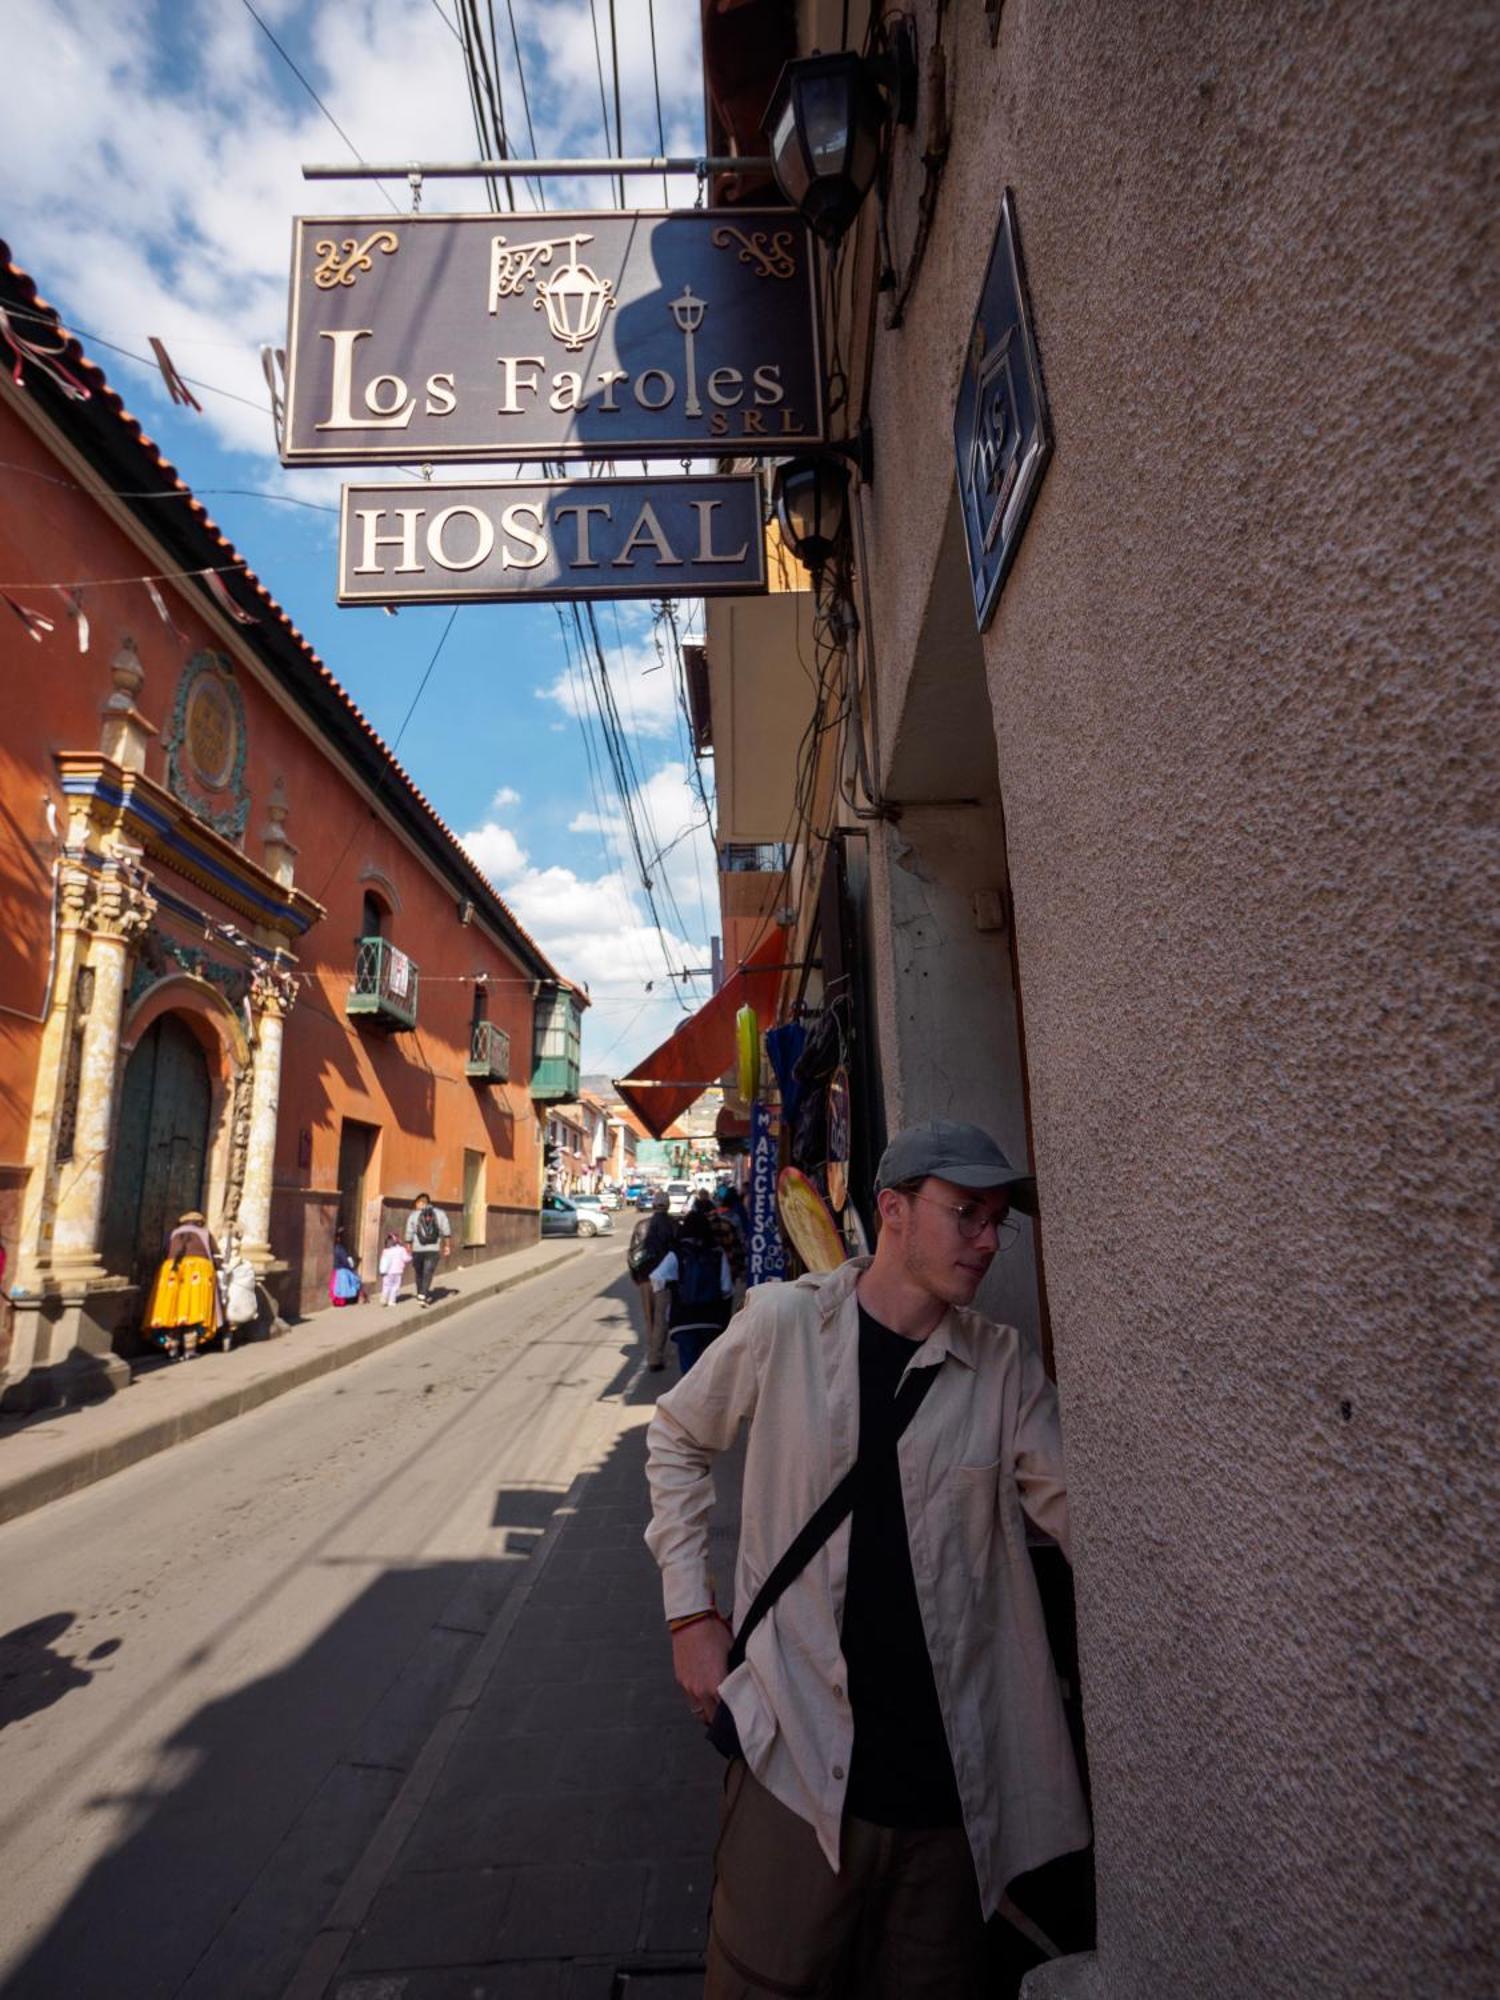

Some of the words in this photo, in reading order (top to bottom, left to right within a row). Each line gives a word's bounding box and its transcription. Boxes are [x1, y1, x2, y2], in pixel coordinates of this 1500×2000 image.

[315, 330, 457, 430] Los
[497, 335, 784, 418] Faroles
[353, 501, 748, 574] HOSTAL
